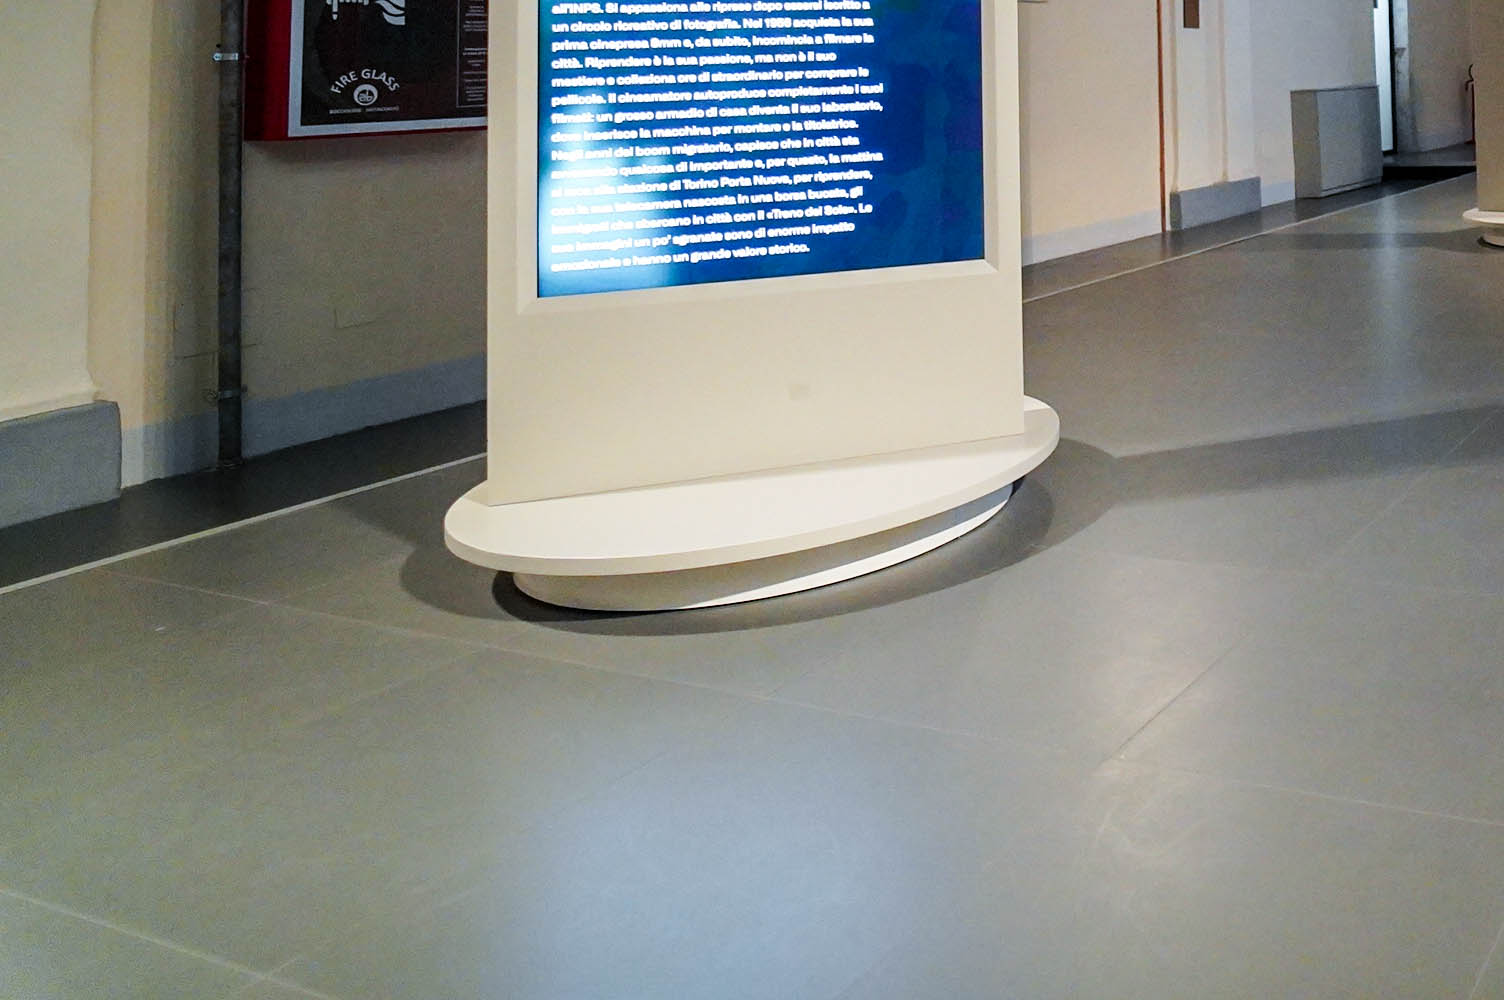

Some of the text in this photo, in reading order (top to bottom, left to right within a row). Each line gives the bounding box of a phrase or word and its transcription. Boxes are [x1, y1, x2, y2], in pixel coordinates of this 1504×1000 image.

[606, 3, 618, 13] Si
[670, 20, 682, 30] di
[841, 17, 852, 26] la
[695, 37, 711, 47] da
[863, 34, 874, 43] la
[663, 55, 675, 66] la
[754, 55, 774, 63] ma
[807, 52, 814, 61] il
[330, 68, 400, 94] FIRE GLASS
[698, 72, 709, 82] di
[859, 67, 869, 77] le
[608, 93, 616, 103] Il
[705, 107, 718, 117] di
[791, 104, 799, 113] il
[640, 128, 651, 138] la
[792, 121, 803, 131] la
[803, 138, 814, 147] in
[676, 162, 687, 172] di
[829, 153, 840, 163] la
[669, 180, 681, 190] di
[738, 194, 749, 204] in
[692, 215, 704, 225] in
[757, 210, 765, 220] il
[858, 204, 873, 213] Le
[755, 228, 765, 238] di
